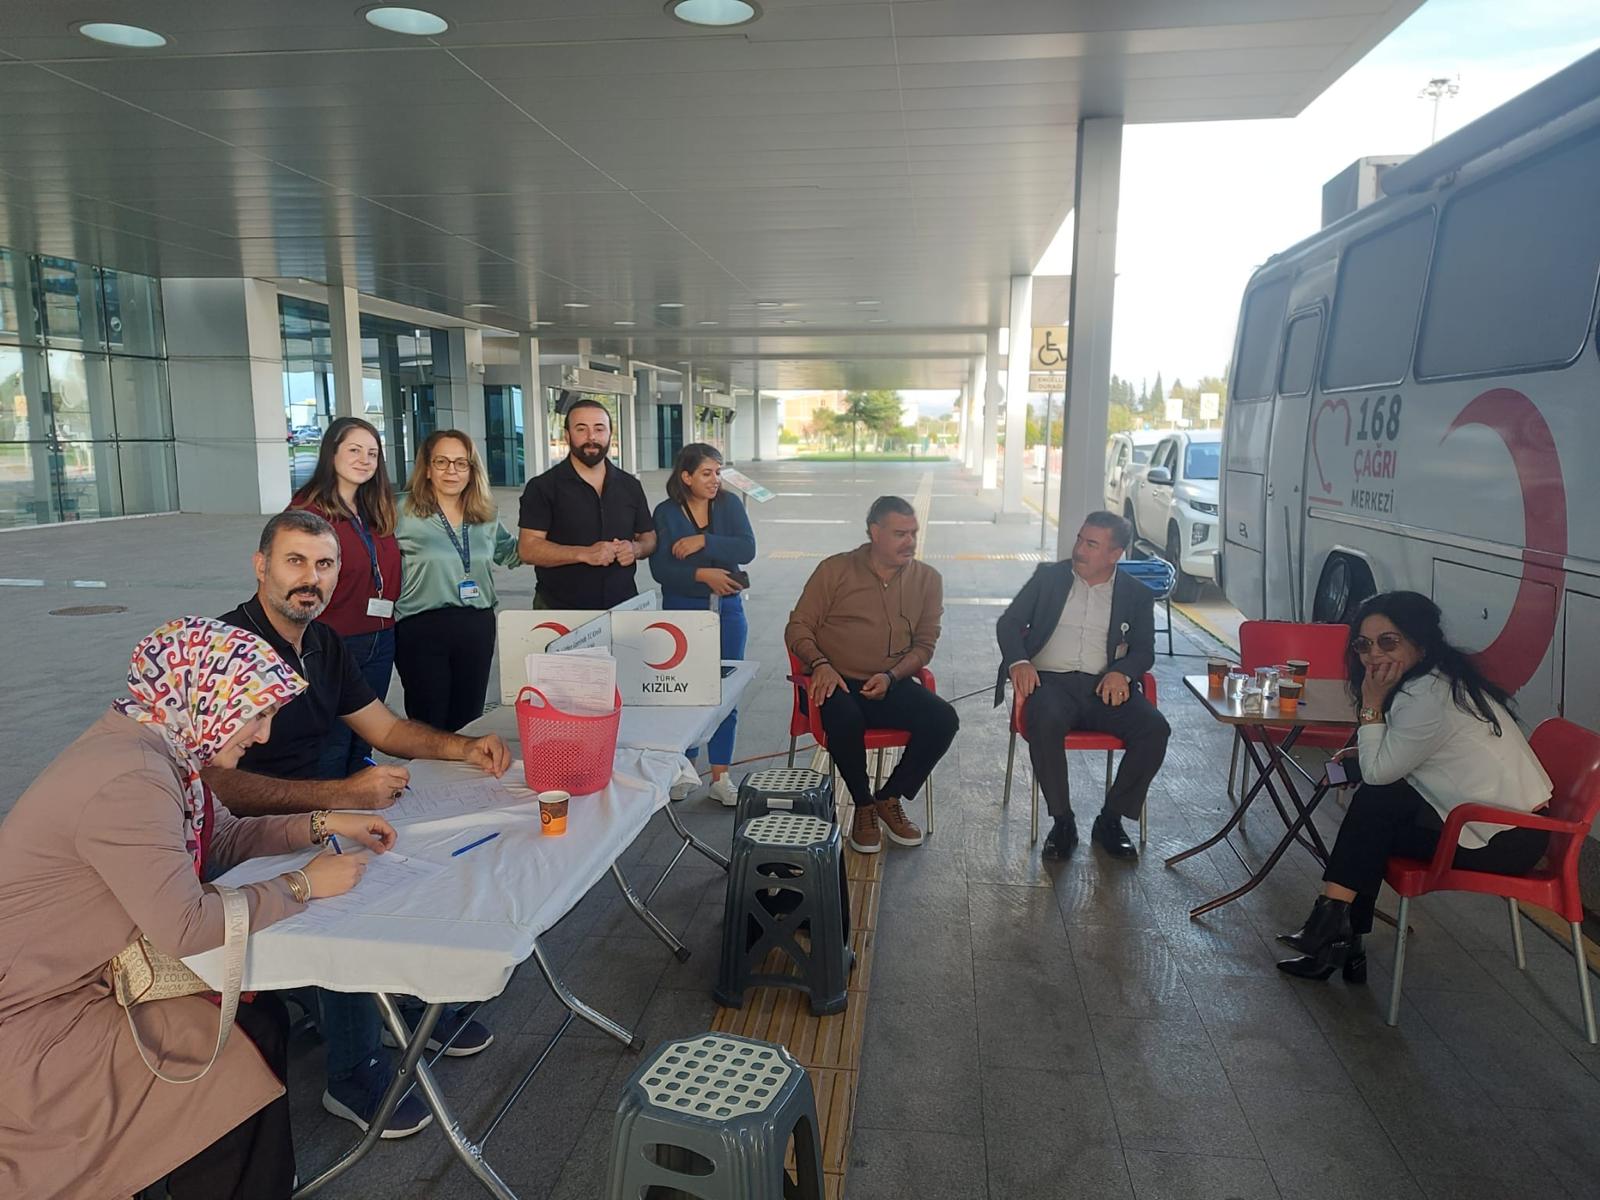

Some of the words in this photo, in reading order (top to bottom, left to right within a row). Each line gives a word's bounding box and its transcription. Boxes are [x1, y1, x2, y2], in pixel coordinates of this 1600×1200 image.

[1357, 394, 1402, 441] 168
[1353, 443, 1397, 483] ÇAĞRI
[1350, 488, 1395, 514] MERKEZİ
[642, 682, 689, 693] KIZILAY
[655, 674, 676, 682] TÜRK
